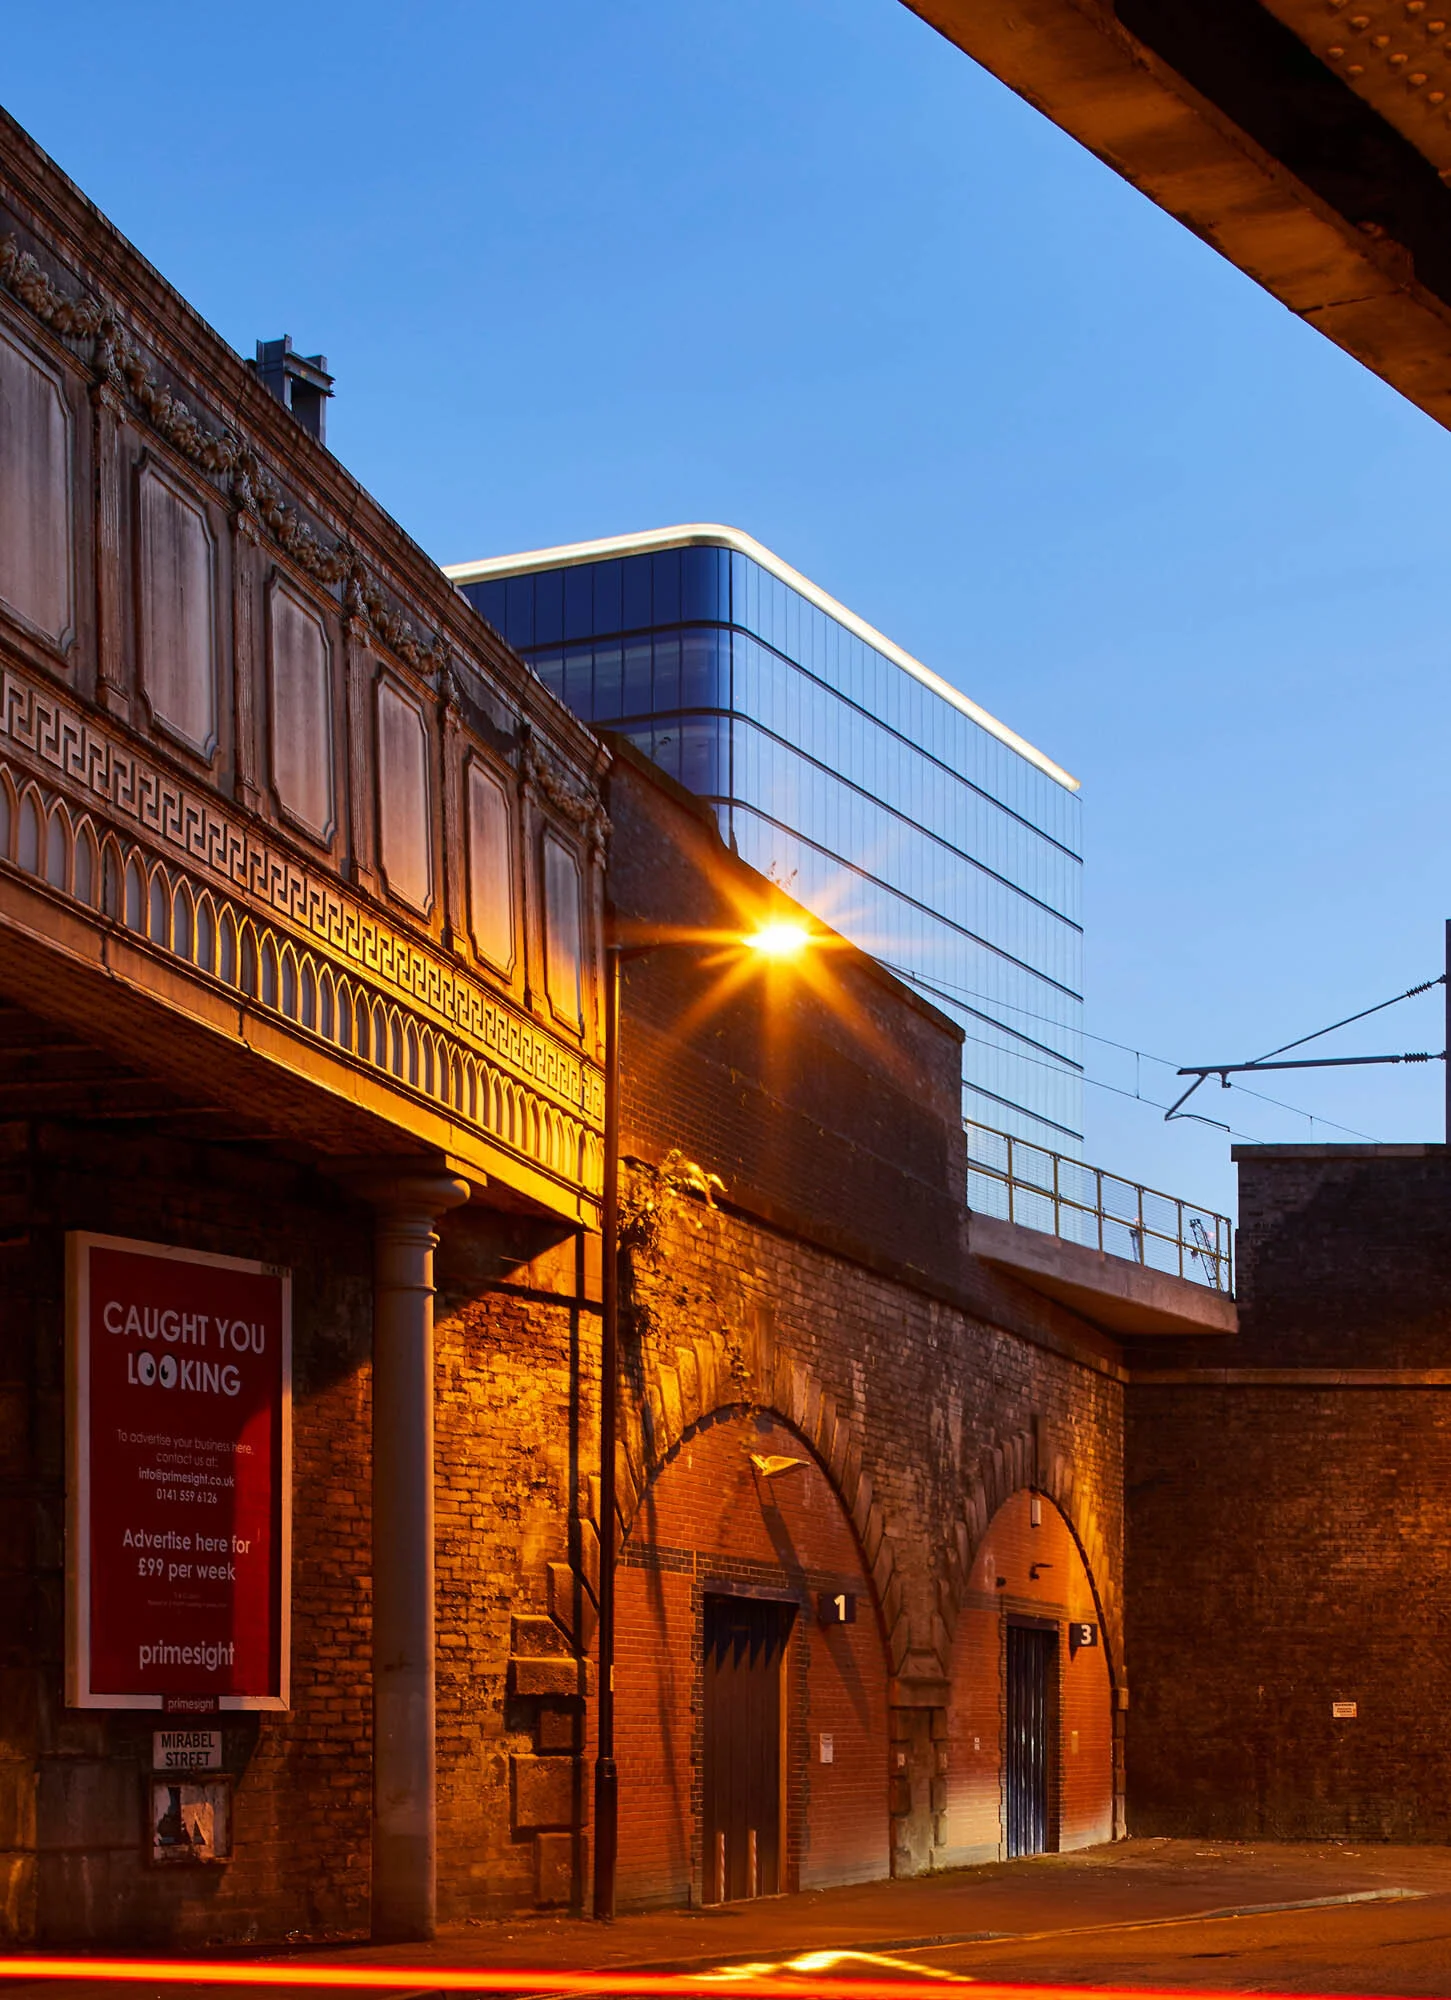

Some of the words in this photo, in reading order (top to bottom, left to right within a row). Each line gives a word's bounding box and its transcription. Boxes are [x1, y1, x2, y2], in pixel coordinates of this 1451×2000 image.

[103, 1300, 209, 1346] CAUGHT
[215, 1317, 265, 1354] YOU
[127, 1351, 241, 1396] LOOKING
[117, 1429, 127, 1442] To
[130, 1432, 171, 1446] advertise
[173, 1437, 192, 1449] your
[195, 1438, 230, 1452] business
[156, 1452, 192, 1464] contact
[194, 1456, 204, 1467] us
[138, 1467, 234, 1488] info@primesight.co.uk
[156, 1488, 176, 1501] 0141
[179, 1489, 195, 1502] 559
[197, 1491, 218, 1504] 6126
[123, 1528, 191, 1550] Advertise
[195, 1533, 228, 1553] here
[231, 1535, 251, 1553] for
[138, 1557, 164, 1576] £99
[168, 1563, 192, 1582] per
[196, 1562, 236, 1581] week
[833, 1594, 847, 1621] 1
[1080, 1625, 1092, 1645] 3
[139, 1640, 235, 1671] primesight
[168, 1697, 214, 1712] primesight
[161, 1733, 215, 1749] MIRABEL
[165, 1751, 211, 1767] STREET
